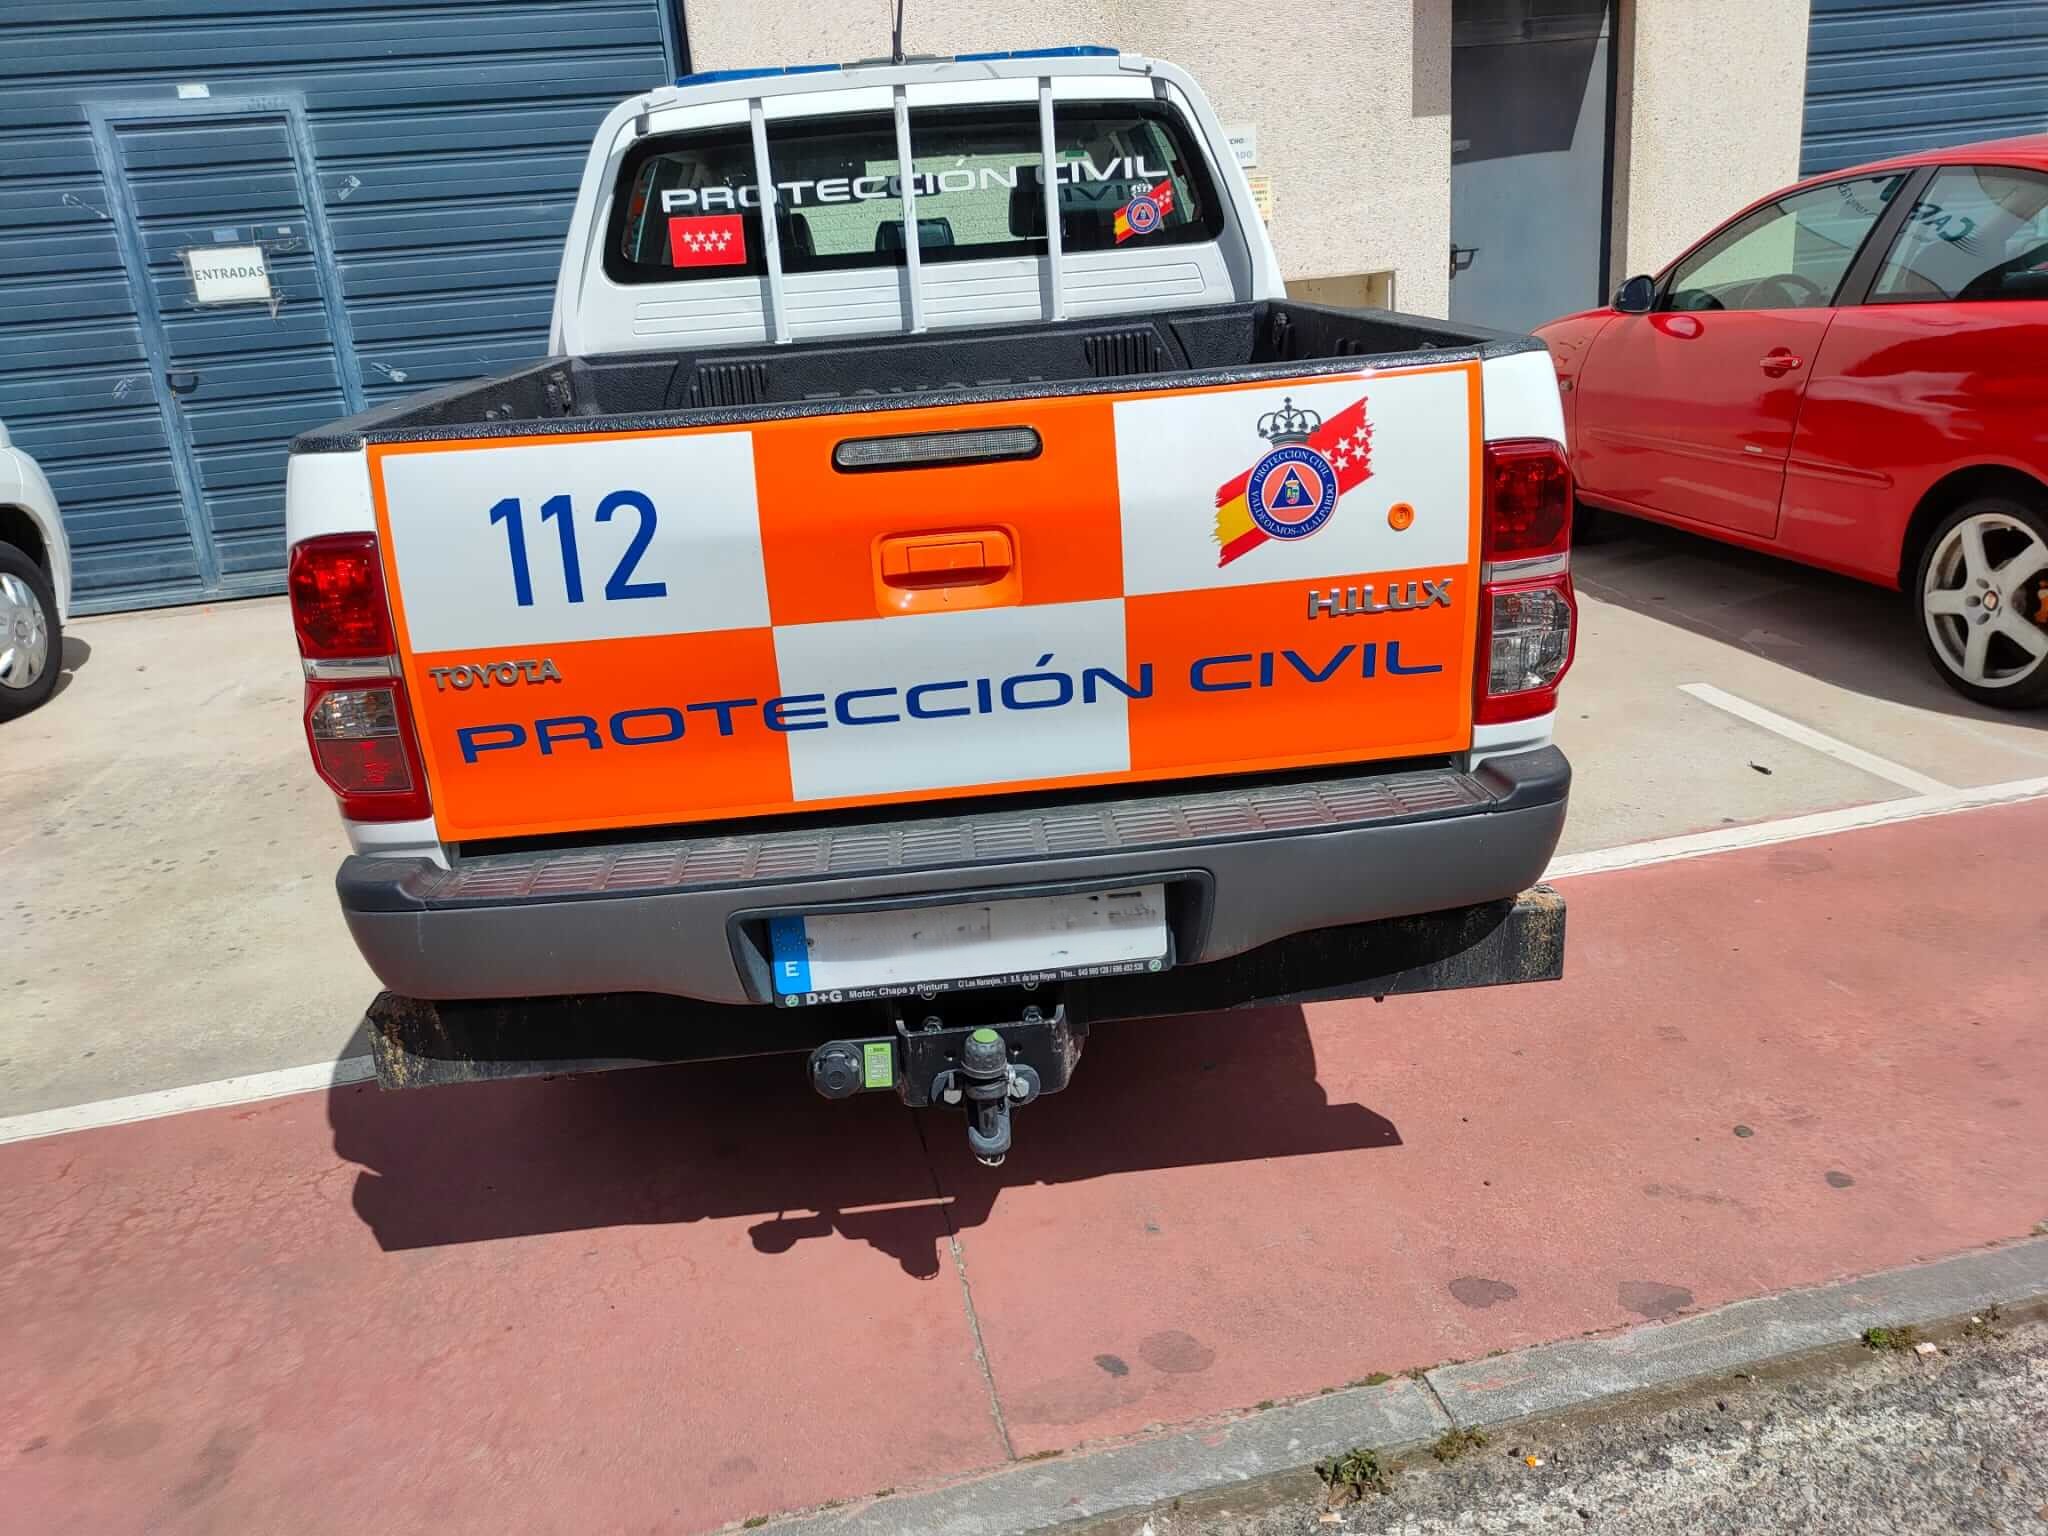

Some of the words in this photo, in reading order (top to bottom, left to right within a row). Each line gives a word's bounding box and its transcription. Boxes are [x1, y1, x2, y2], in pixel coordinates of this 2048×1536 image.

[661, 158, 1018, 213] PROTECCIÓN
[1035, 156, 1169, 184] CIVIL
[194, 266, 265, 281] ENTRADAS
[1309, 454, 1330, 478] CIVIL
[489, 490, 667, 607] 112
[1307, 577, 1453, 621] HILUX
[429, 659, 563, 691] TOYOTA
[456, 653, 1154, 764] PROTECCIÓN
[1190, 640, 1444, 692] CIVIL
[785, 960, 800, 977] E
[806, 990, 843, 1006] D+G
[849, 989, 877, 1000] Motor,
[879, 985, 907, 998] Chapa
[909, 986, 916, 995] y
[917, 982, 949, 993] Pintura
